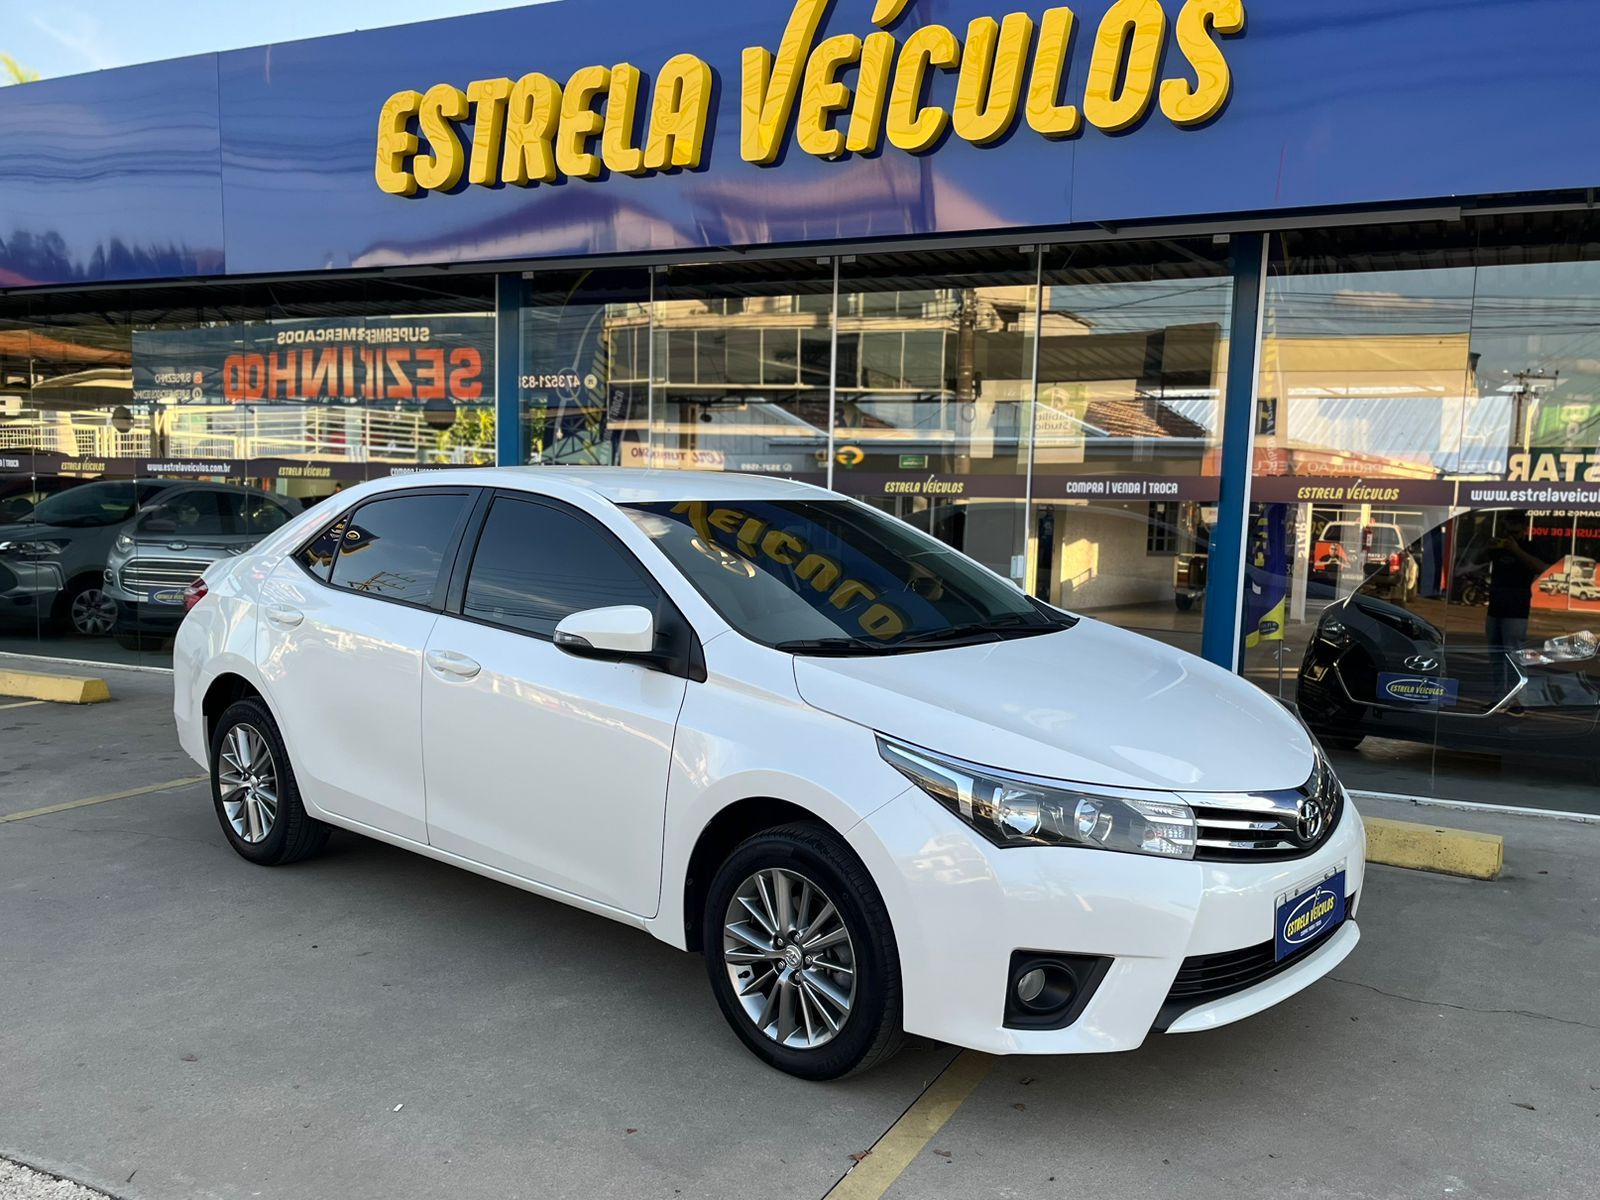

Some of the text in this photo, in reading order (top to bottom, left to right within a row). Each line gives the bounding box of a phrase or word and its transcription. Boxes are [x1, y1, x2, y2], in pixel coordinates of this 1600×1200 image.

[375, 0, 1245, 197] ESTRELA VEÍCULOS
[278, 466, 302, 476] ESTRELA
[884, 481, 921, 493] ESTRELA
[1066, 481, 1178, 494] COMPRA VENDA TROCA
[1297, 487, 1344, 499] ESTRELA
[1390, 684, 1415, 694] ESTRELA
[1287, 911, 1310, 937] ESTRELA
